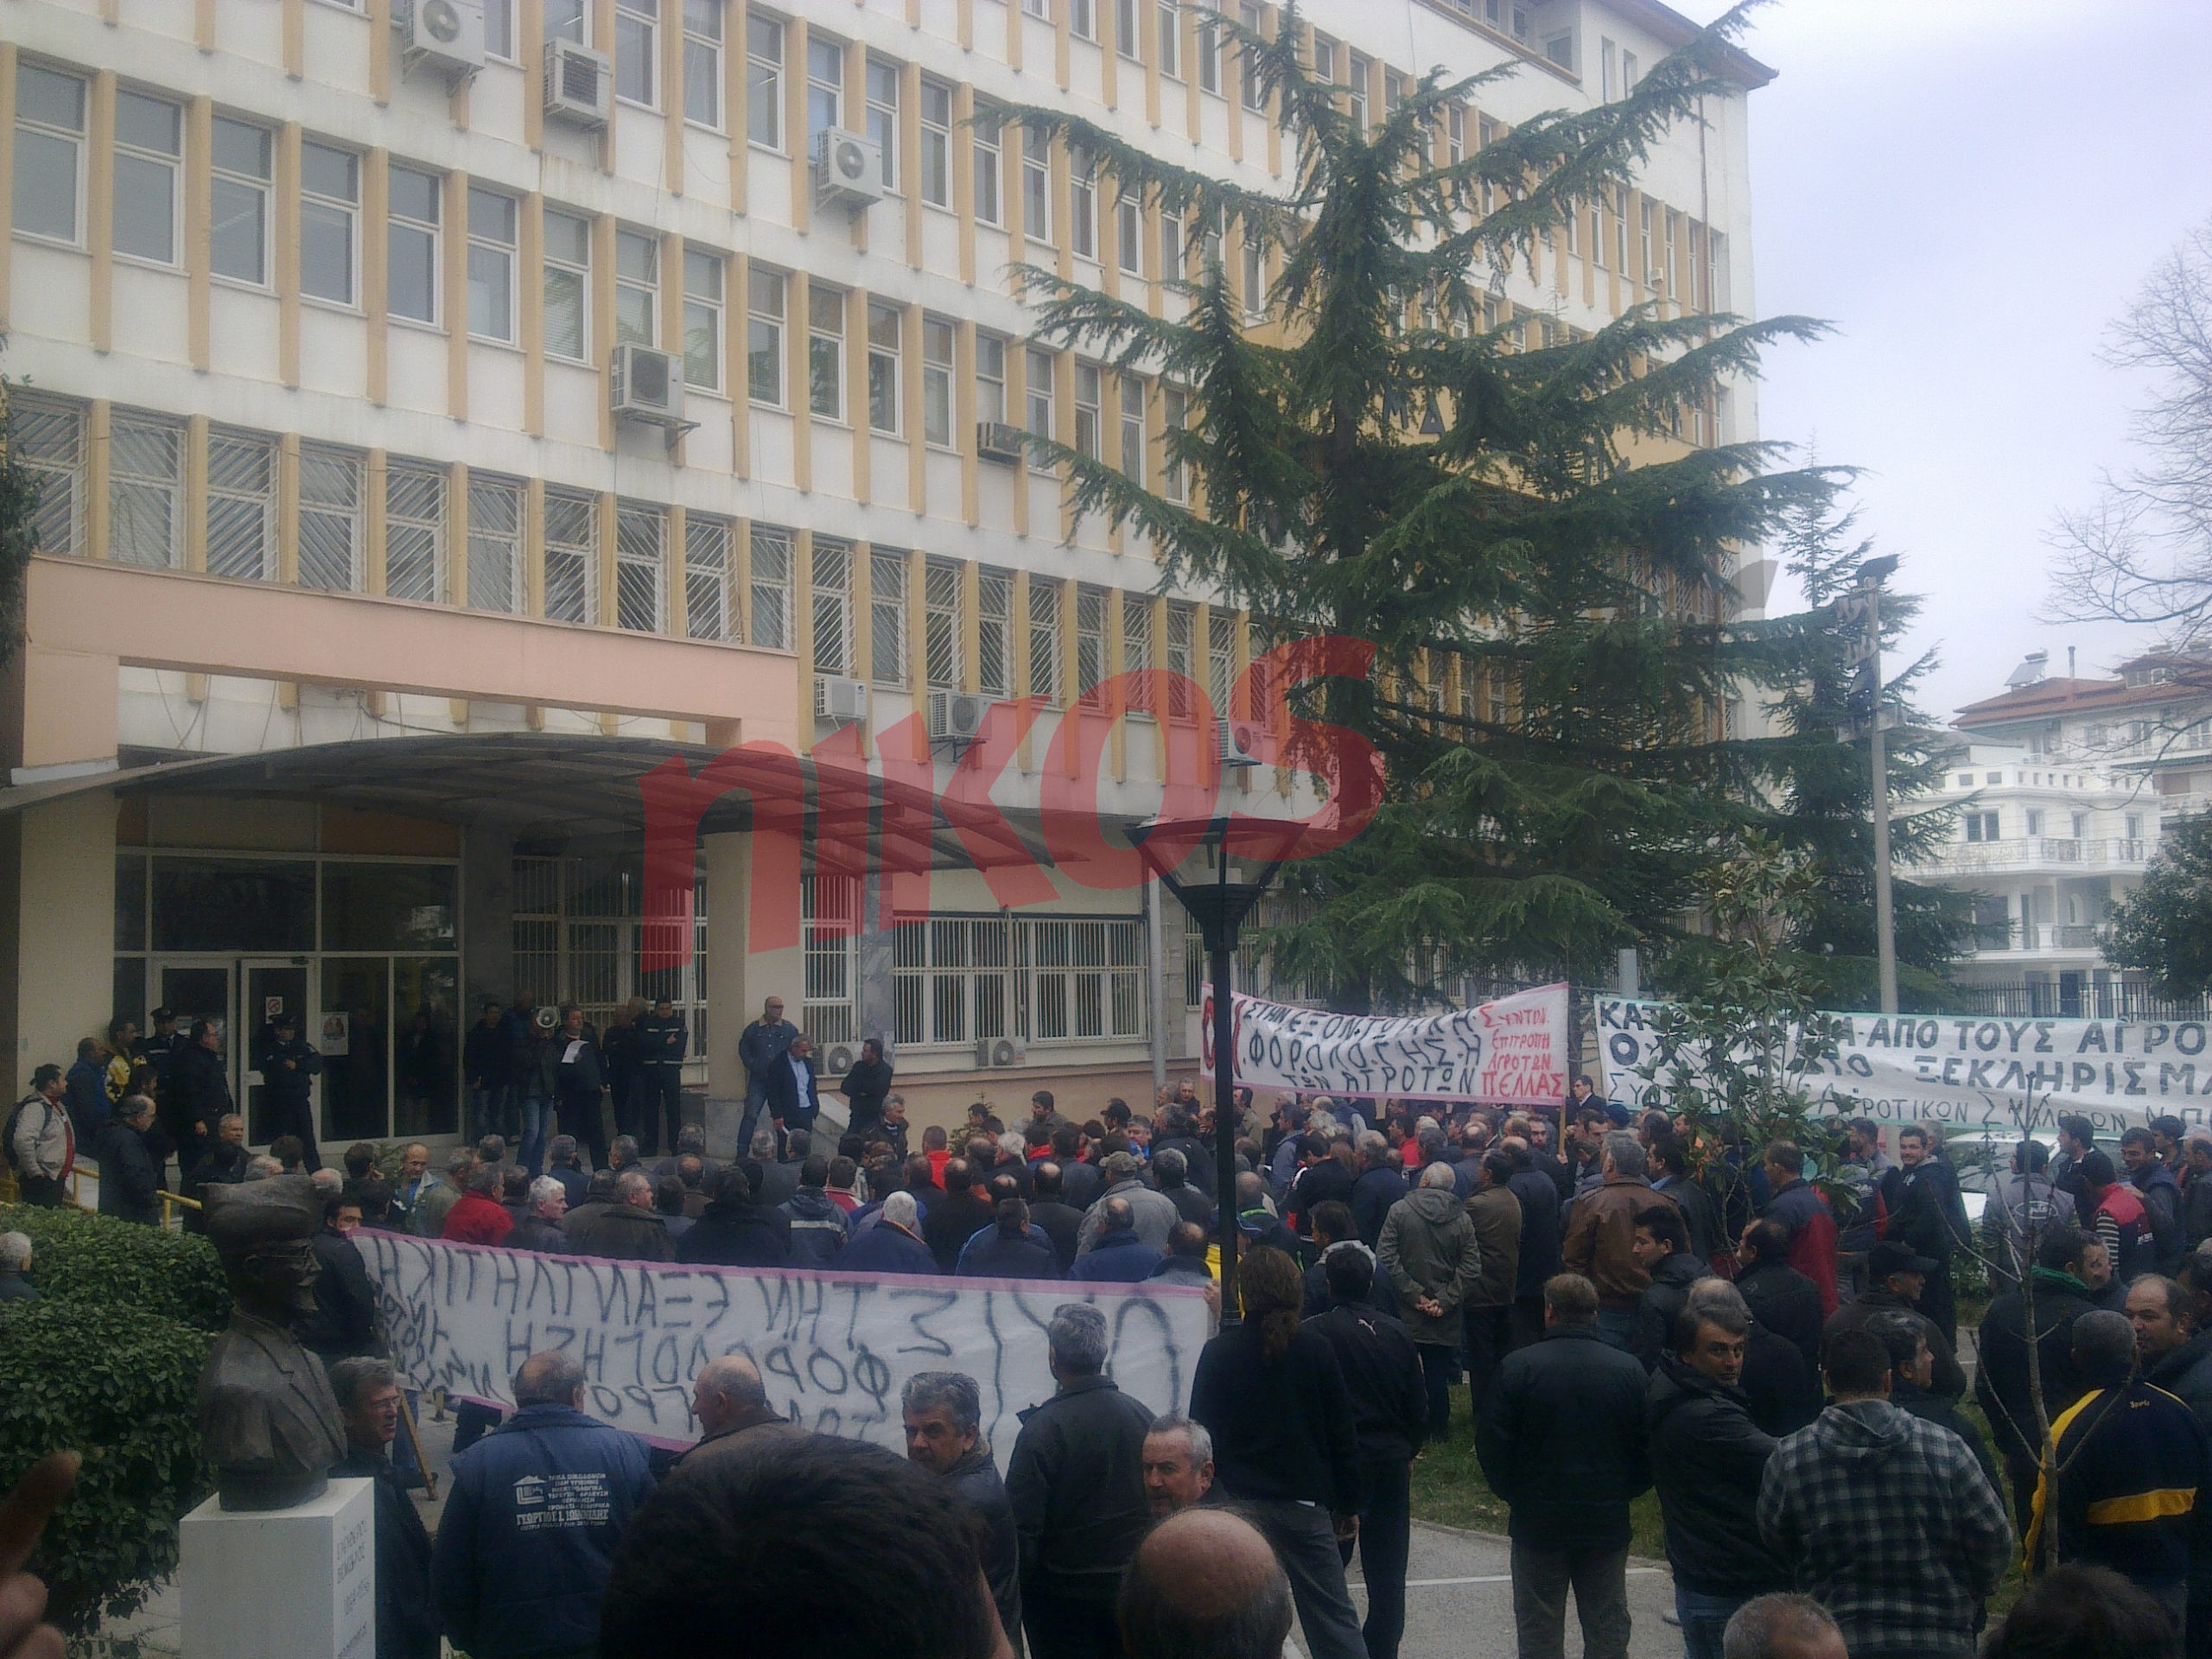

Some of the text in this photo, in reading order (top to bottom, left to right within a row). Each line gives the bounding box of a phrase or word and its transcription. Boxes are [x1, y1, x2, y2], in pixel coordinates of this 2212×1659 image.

[1249, 1028, 1482, 1071] ΦΟΡΟΛΟΓΗΣΗ
[1491, 1028, 1551, 1050] ΕΠΙΤΡΟΠΗ
[1866, 1018, 1940, 1049] ΑΠΟ
[1954, 1020, 2056, 1053] ΤΟΥΣ
[2076, 1021, 2207, 1056] ΑΓΡΟ
[1487, 1052, 1552, 1071] ΑΓΡΟΤΩΝ
[1281, 1065, 1476, 1094] ΤΩΝ ΑΓΡΟΤΩΝ
[1481, 1071, 1565, 1097] ΠΕΛΛΑΣ
